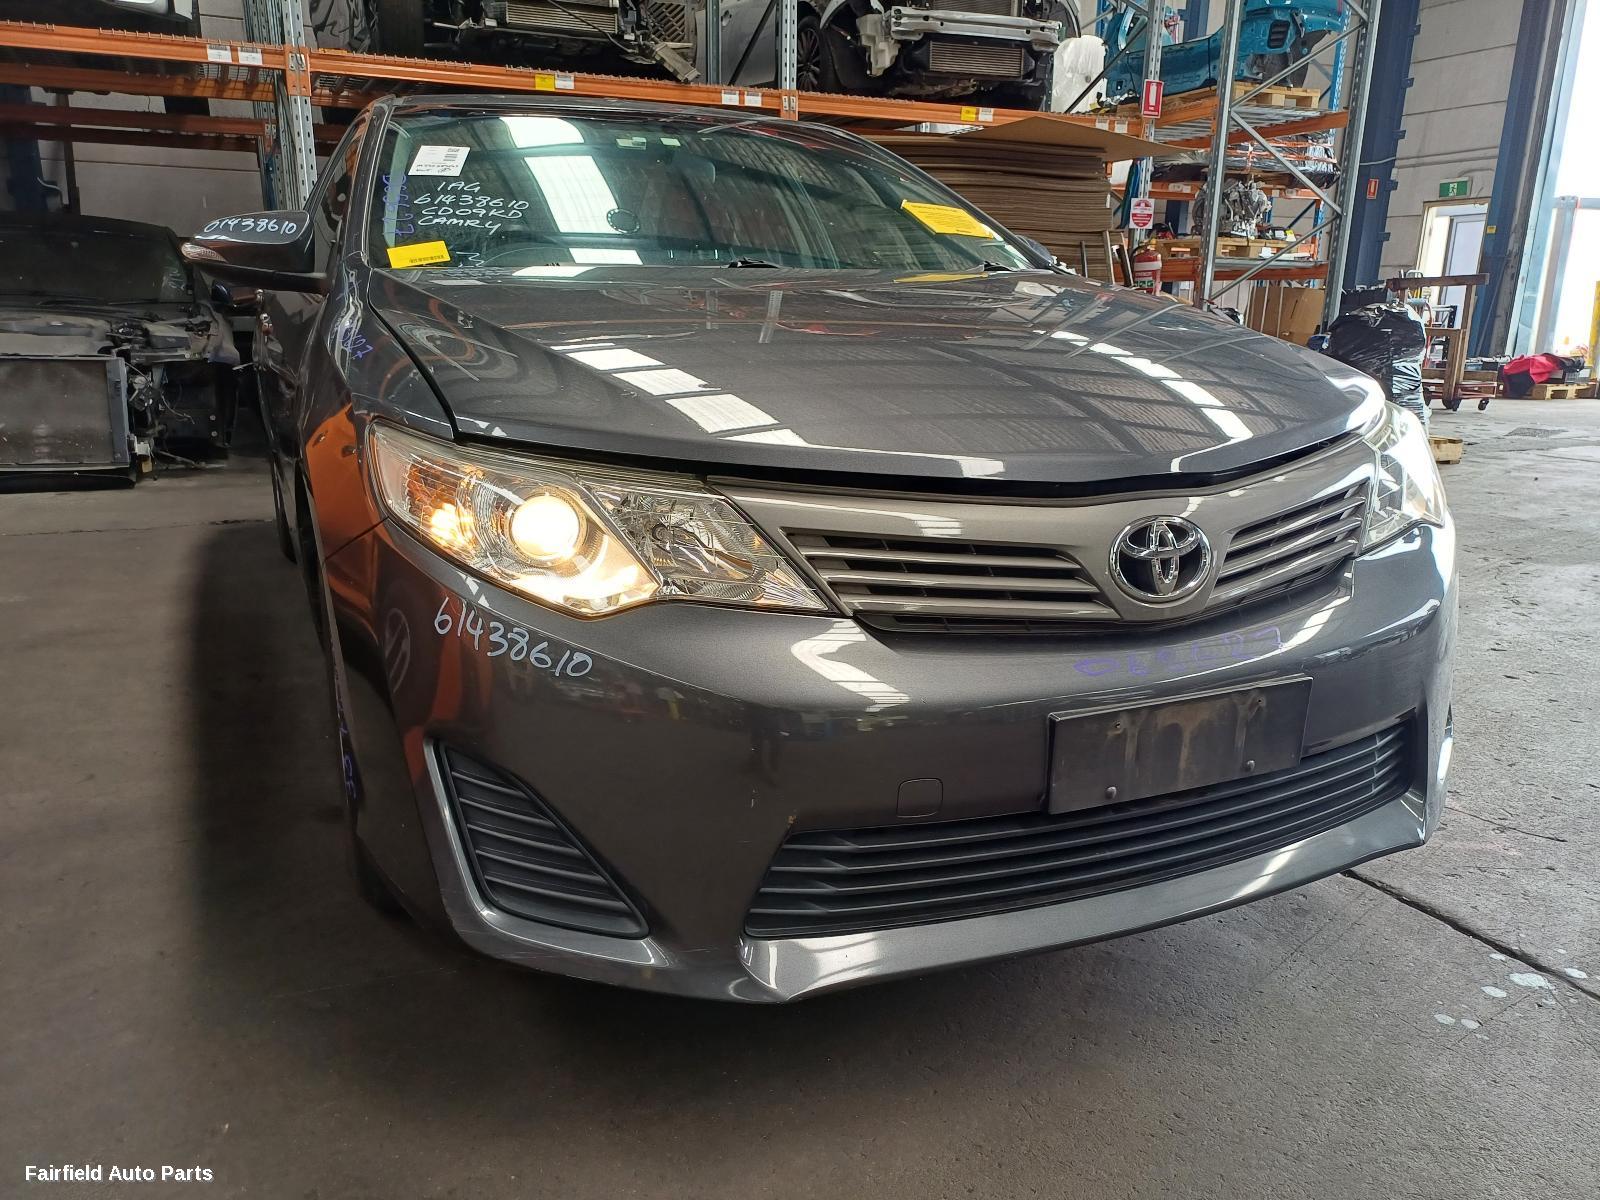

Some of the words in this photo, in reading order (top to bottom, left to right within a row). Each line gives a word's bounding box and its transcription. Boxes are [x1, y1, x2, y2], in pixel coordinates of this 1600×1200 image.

[413, 193, 530, 210] 61438610
[417, 215, 502, 235] CAMRY
[434, 596, 593, 677] 61438610
